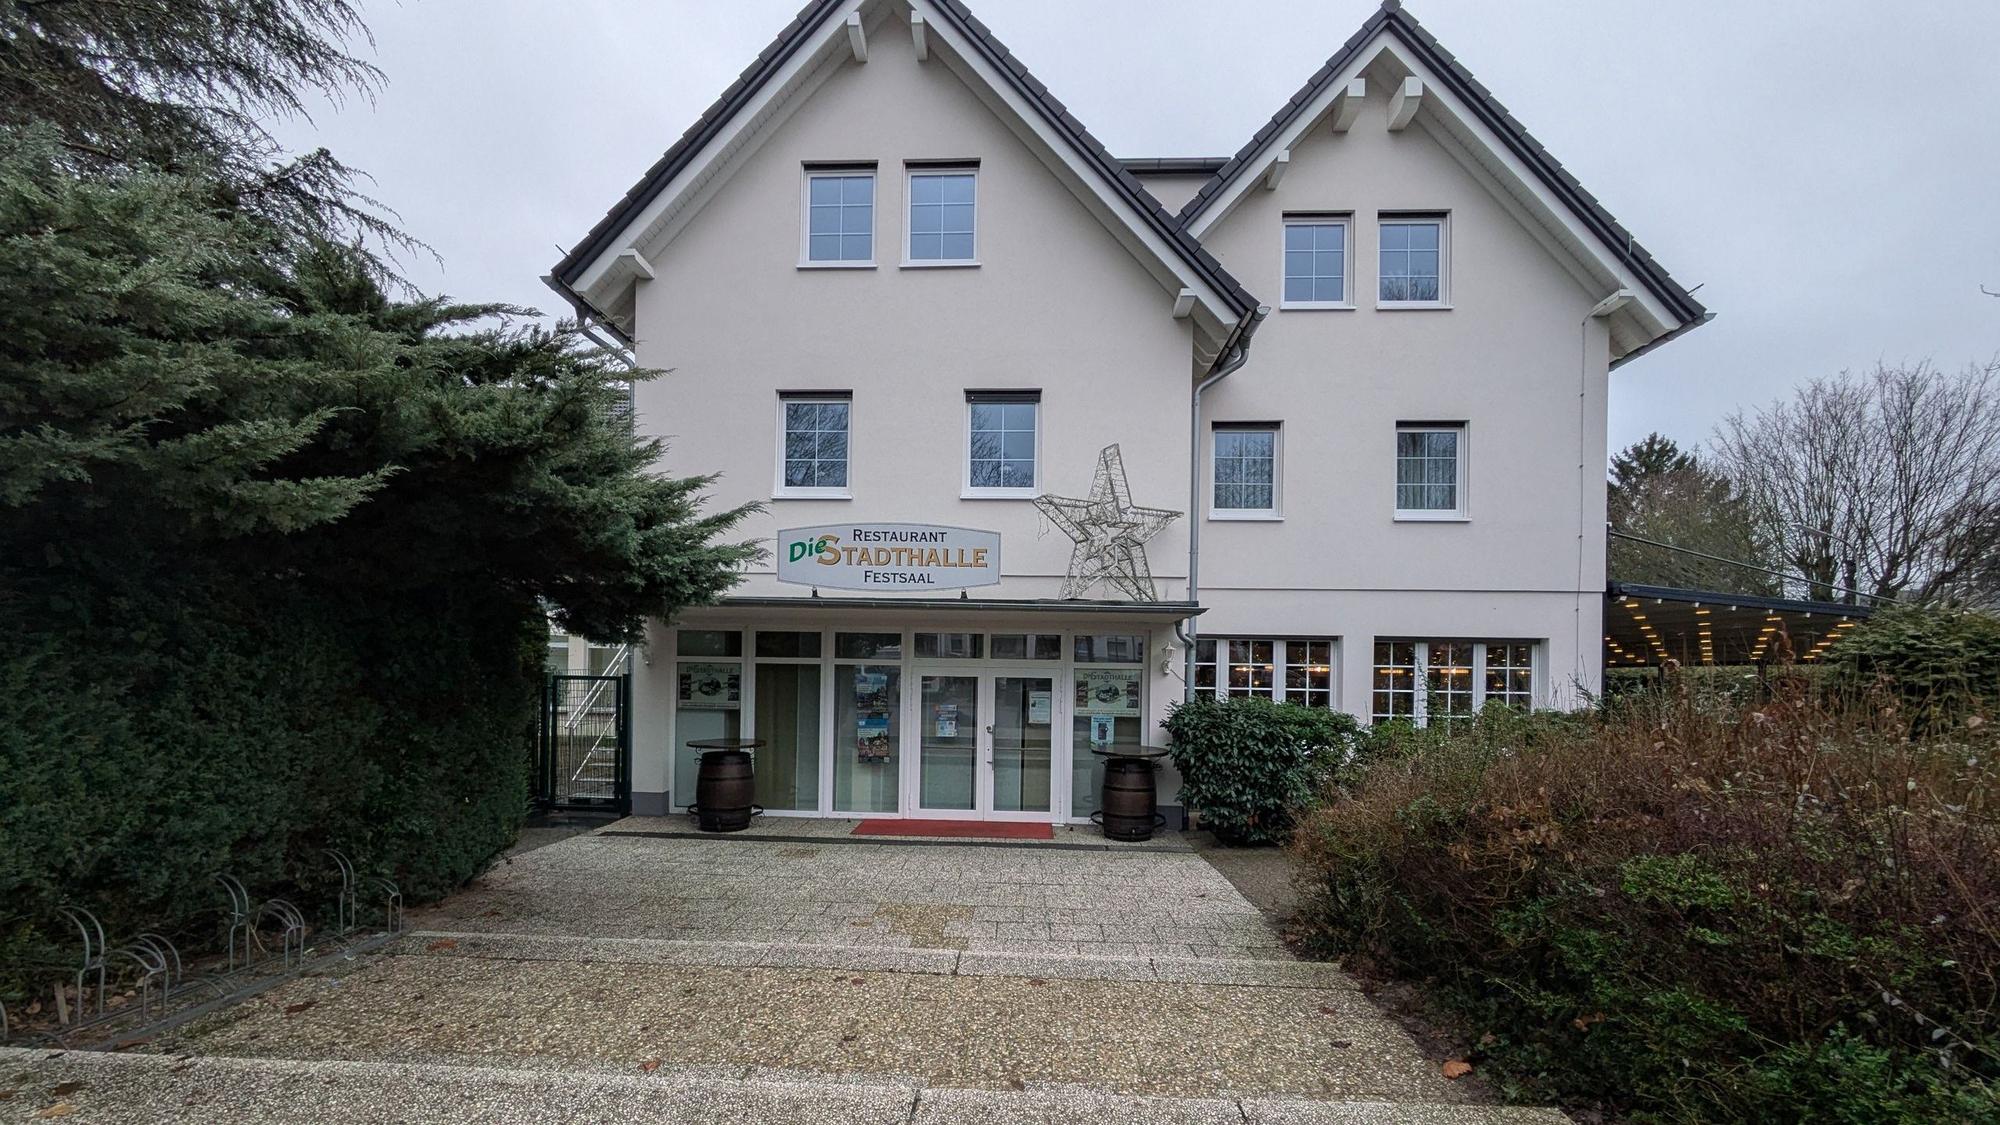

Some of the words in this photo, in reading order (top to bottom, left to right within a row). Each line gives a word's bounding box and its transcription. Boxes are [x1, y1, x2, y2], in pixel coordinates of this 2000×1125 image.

[853, 529, 947, 543] RESTAURANT
[789, 537, 827, 563] Die
[817, 535, 988, 568] STADTHALLE
[864, 570, 935, 584] FESTSAAL
